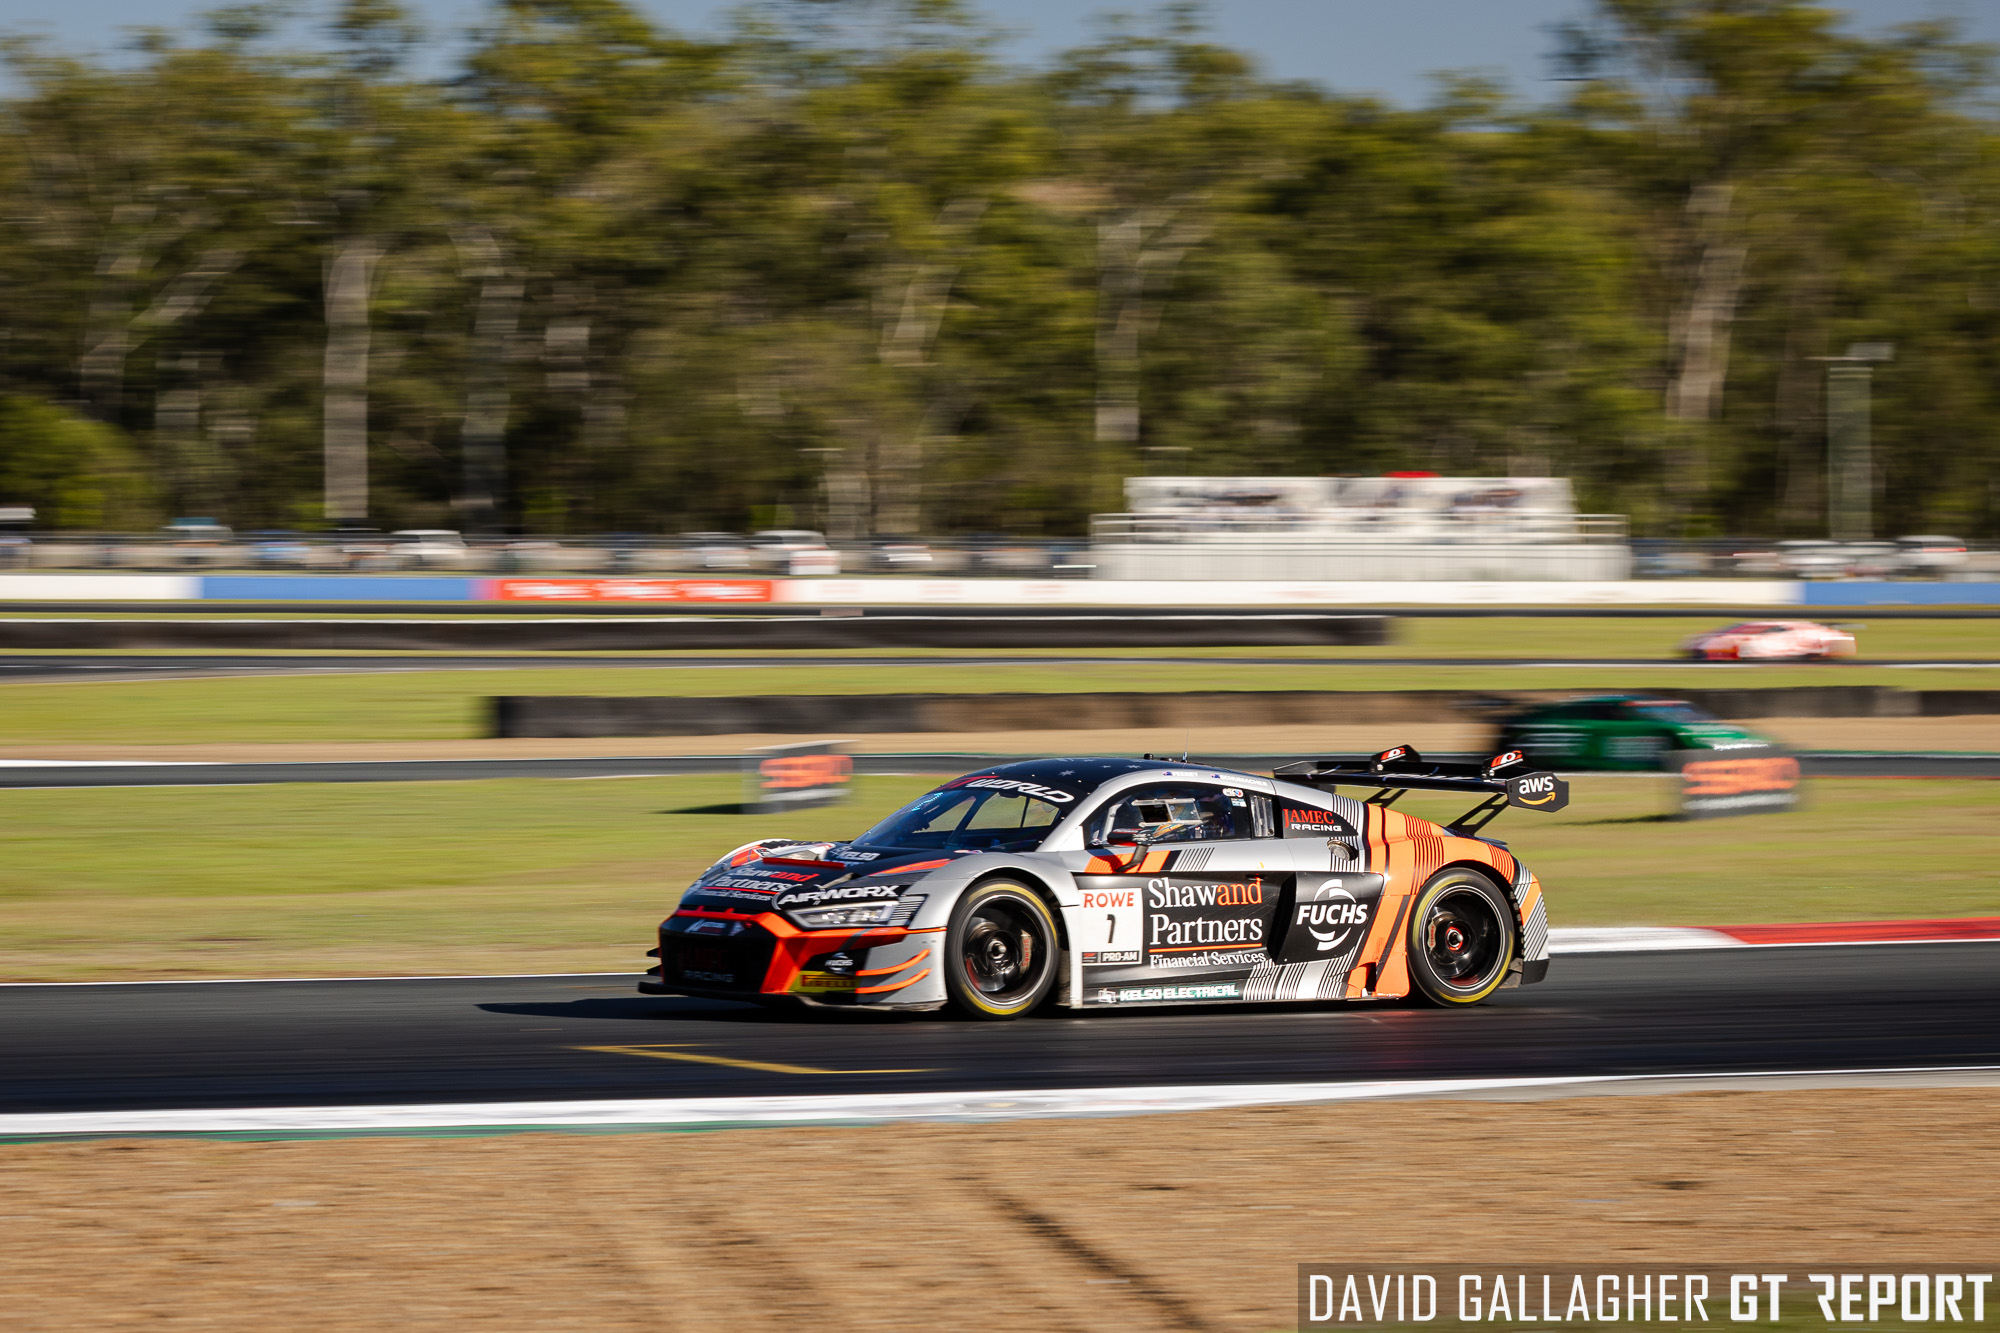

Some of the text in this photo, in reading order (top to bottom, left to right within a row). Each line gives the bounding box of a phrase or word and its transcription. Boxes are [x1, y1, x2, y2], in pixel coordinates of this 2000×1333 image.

[965, 779, 1075, 803] WORLD
[1519, 776, 1554, 795] aws
[1283, 809, 1334, 828] JAMEC
[1291, 823, 1342, 832] RACING
[708, 876, 793, 892] Partners
[778, 884, 899, 905] AIRWORX
[1083, 892, 1134, 908] ROWE
[1296, 904, 1368, 925] FUCHS
[1149, 914, 1263, 945] Partners
[1102, 951, 1138, 962] PRO-AM
[1149, 950, 1266, 969] Financial Services
[1120, 984, 1240, 1001] KELSO ELECTRICAL
